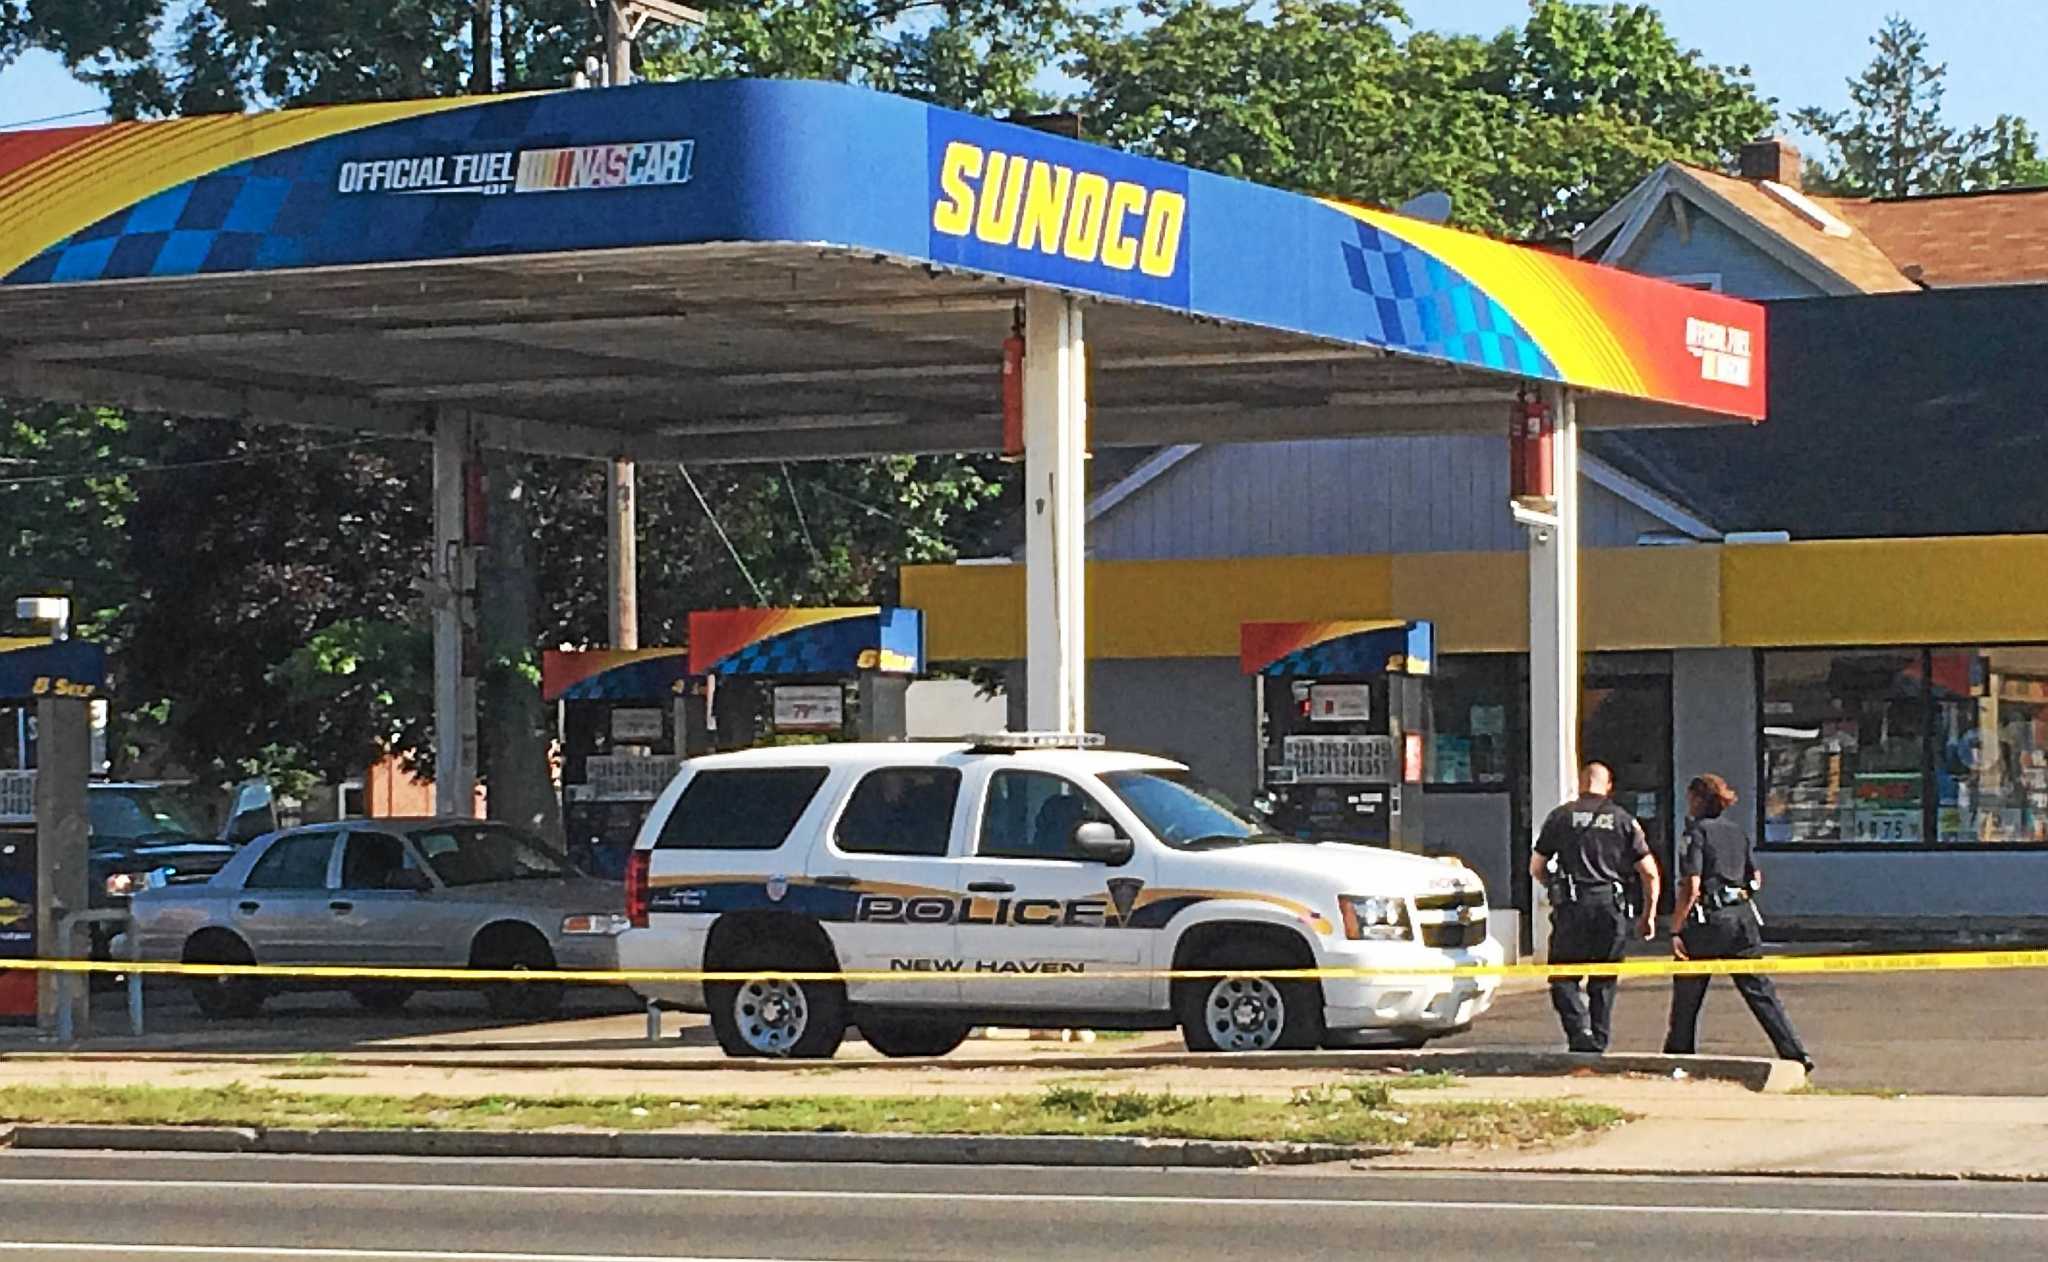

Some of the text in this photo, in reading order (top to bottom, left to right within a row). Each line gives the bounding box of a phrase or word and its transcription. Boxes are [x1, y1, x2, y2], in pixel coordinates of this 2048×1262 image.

[338, 151, 515, 193] OFFICIAL FUEL
[569, 141, 691, 187] NASCAR
[933, 140, 1186, 278] SUNOCO
[854, 893, 1108, 928] POLICE
[890, 958, 1085, 975] NEW HAVEN
